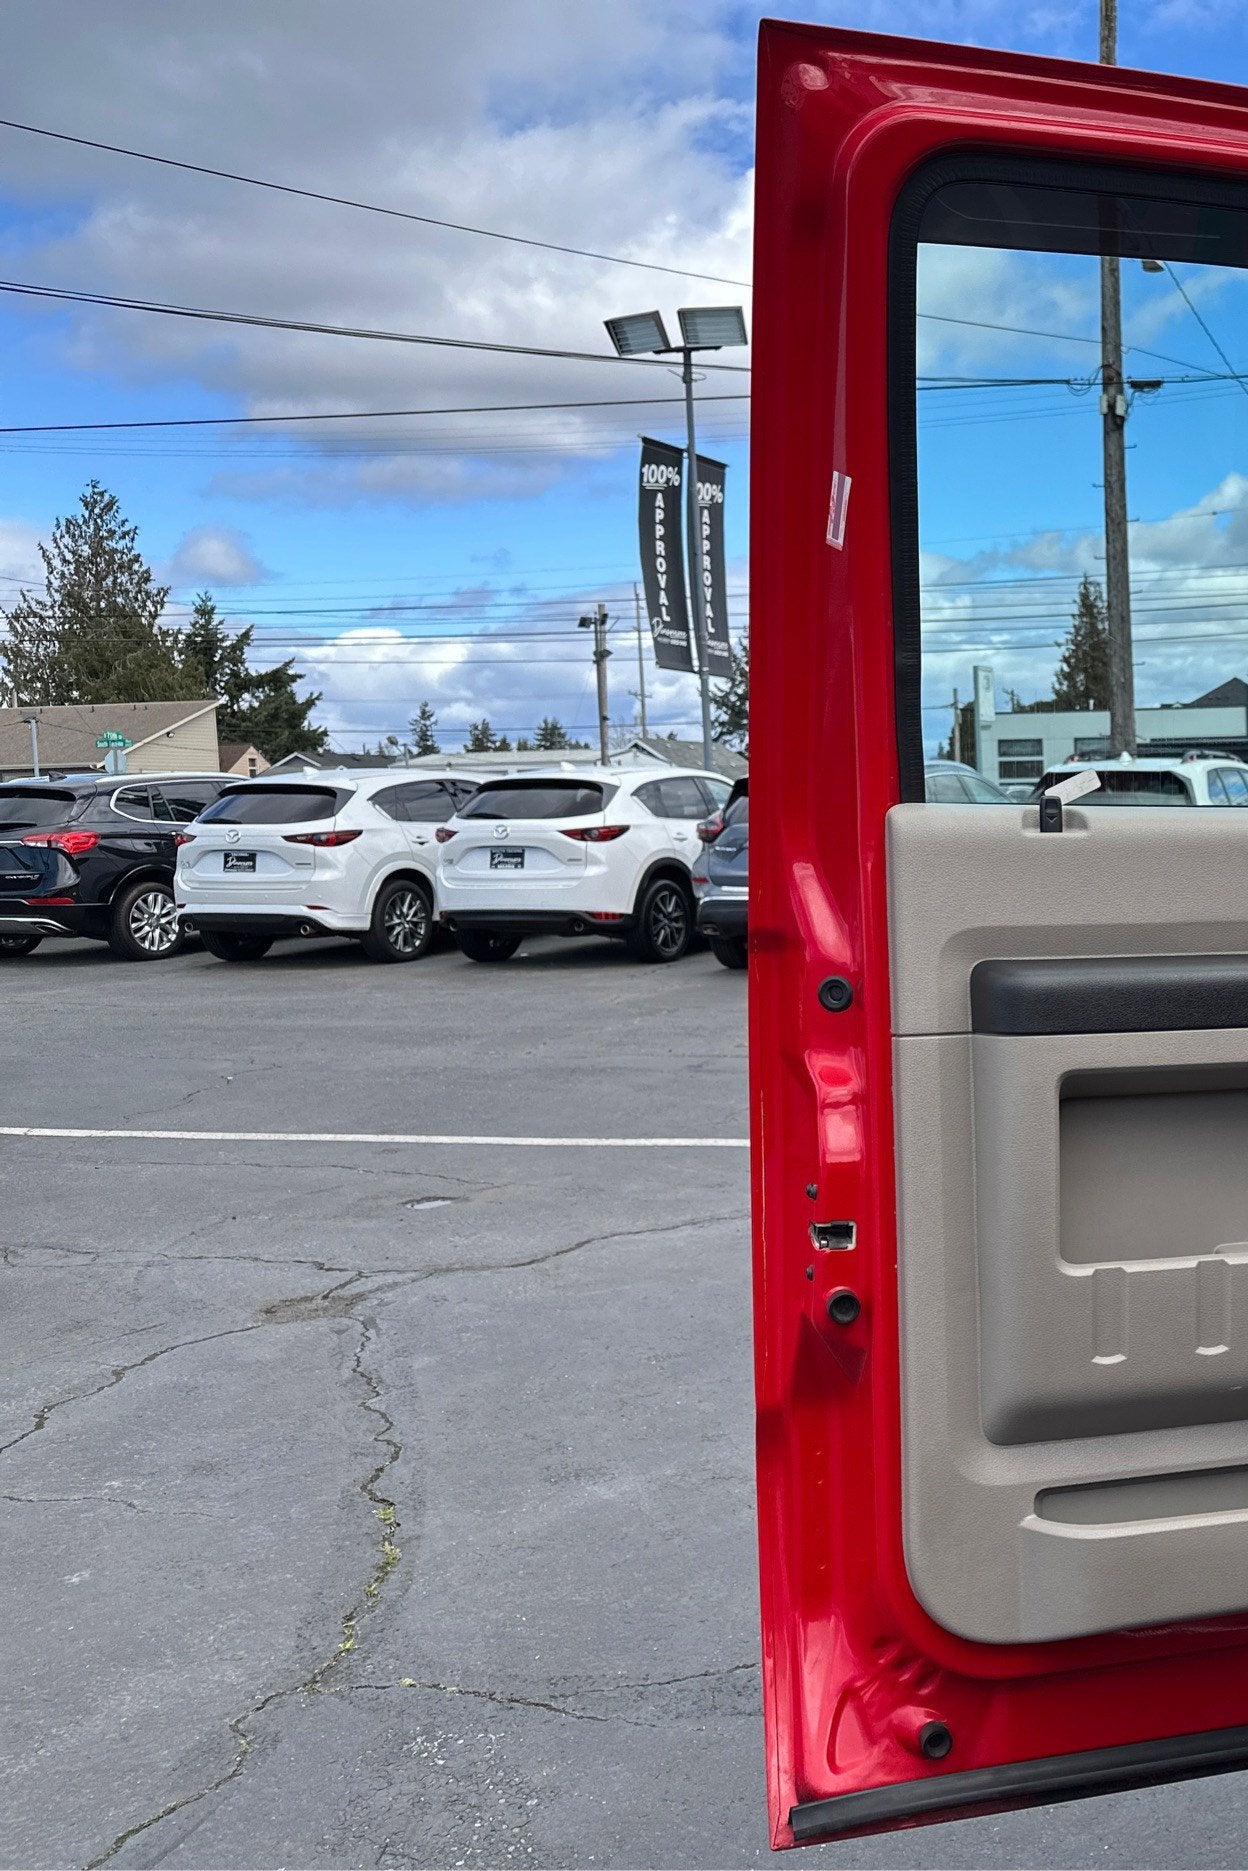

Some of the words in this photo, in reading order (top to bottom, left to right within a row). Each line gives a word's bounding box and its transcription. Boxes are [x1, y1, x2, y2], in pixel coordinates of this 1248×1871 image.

[641, 463, 680, 487] 100%
[696, 481, 724, 504] 00%
[654, 492, 671, 622] APPROVAL
[701, 508, 715, 634] APPROVAL
